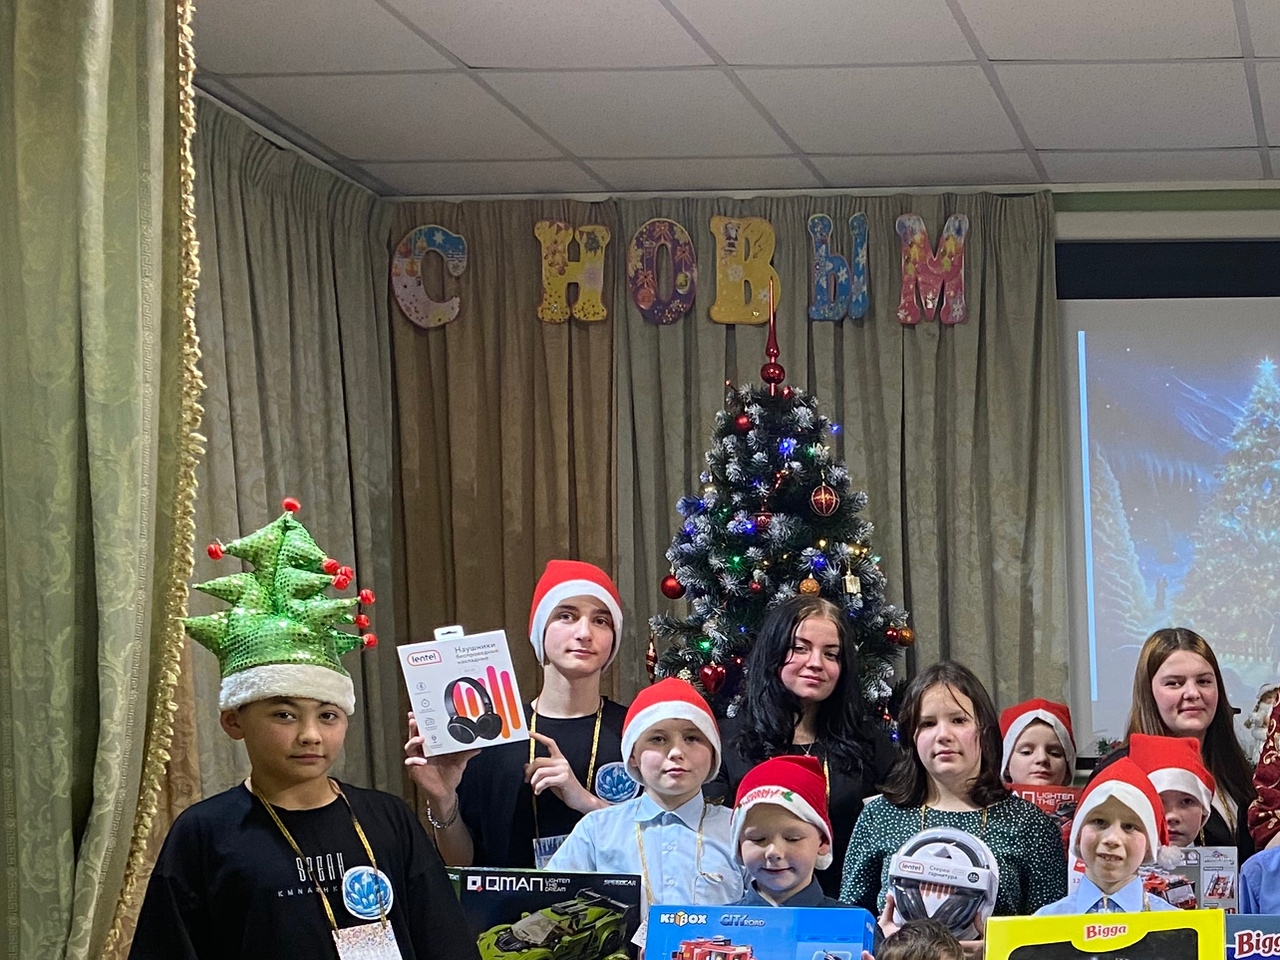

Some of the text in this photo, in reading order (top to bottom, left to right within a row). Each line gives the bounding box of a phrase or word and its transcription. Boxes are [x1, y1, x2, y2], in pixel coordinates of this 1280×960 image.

[392, 223, 467, 329] С
[534, 212, 969, 325] НОВЫМ
[411, 652, 437, 664] lentel
[1036, 791, 1075, 800] LIGHTEN
[1085, 924, 1127, 940] Bigga
